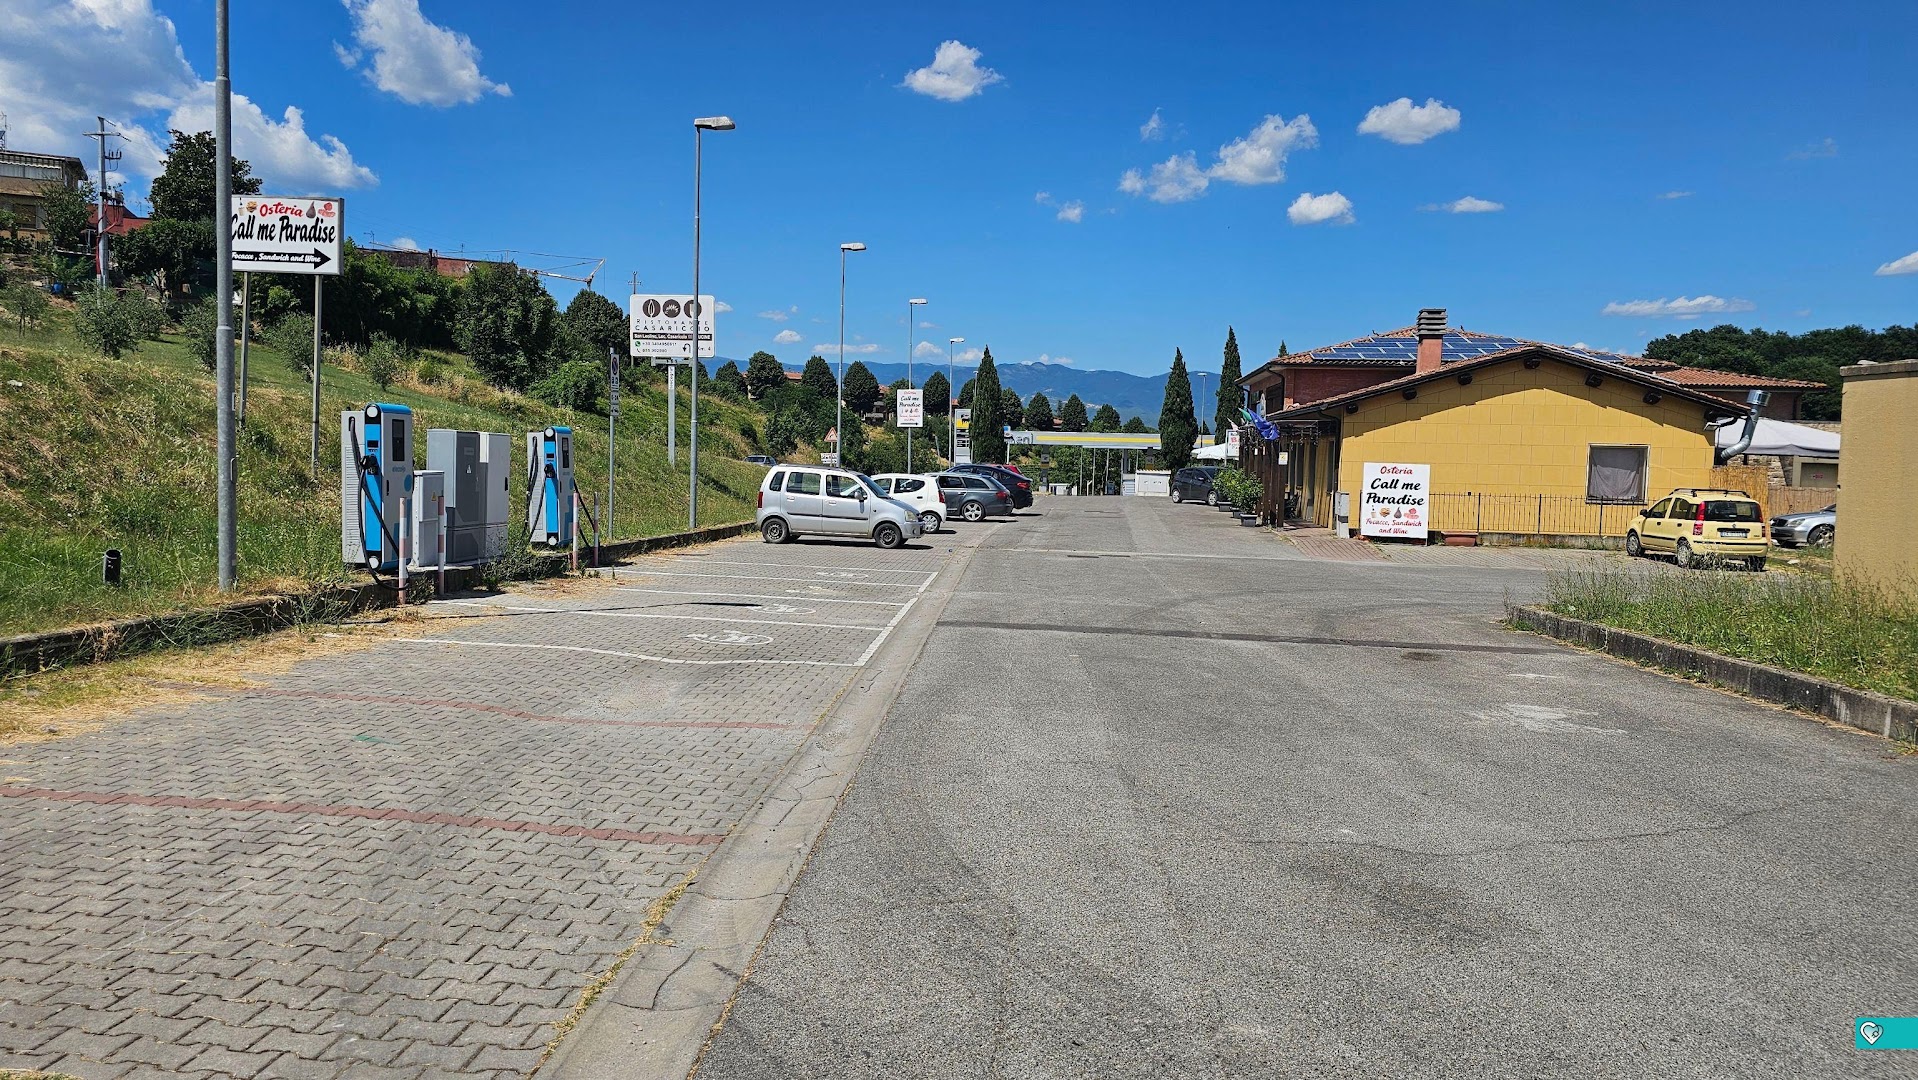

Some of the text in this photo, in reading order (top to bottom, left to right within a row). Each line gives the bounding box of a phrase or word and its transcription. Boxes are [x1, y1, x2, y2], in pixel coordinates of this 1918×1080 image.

[259, 202, 303, 217] Osteria
[257, 223, 276, 242] me
[279, 215, 336, 243] Paradise
[258, 252, 290, 262] Sandwich
[290, 254, 305, 262] and
[304, 255, 321, 263] Wine
[1380, 465, 1413, 475] Osteria
[1370, 477, 1422, 491] Call me
[1365, 492, 1425, 506] Paradise
[1391, 519, 1422, 527] Sandwich
[1392, 527, 1408, 535] Wine
